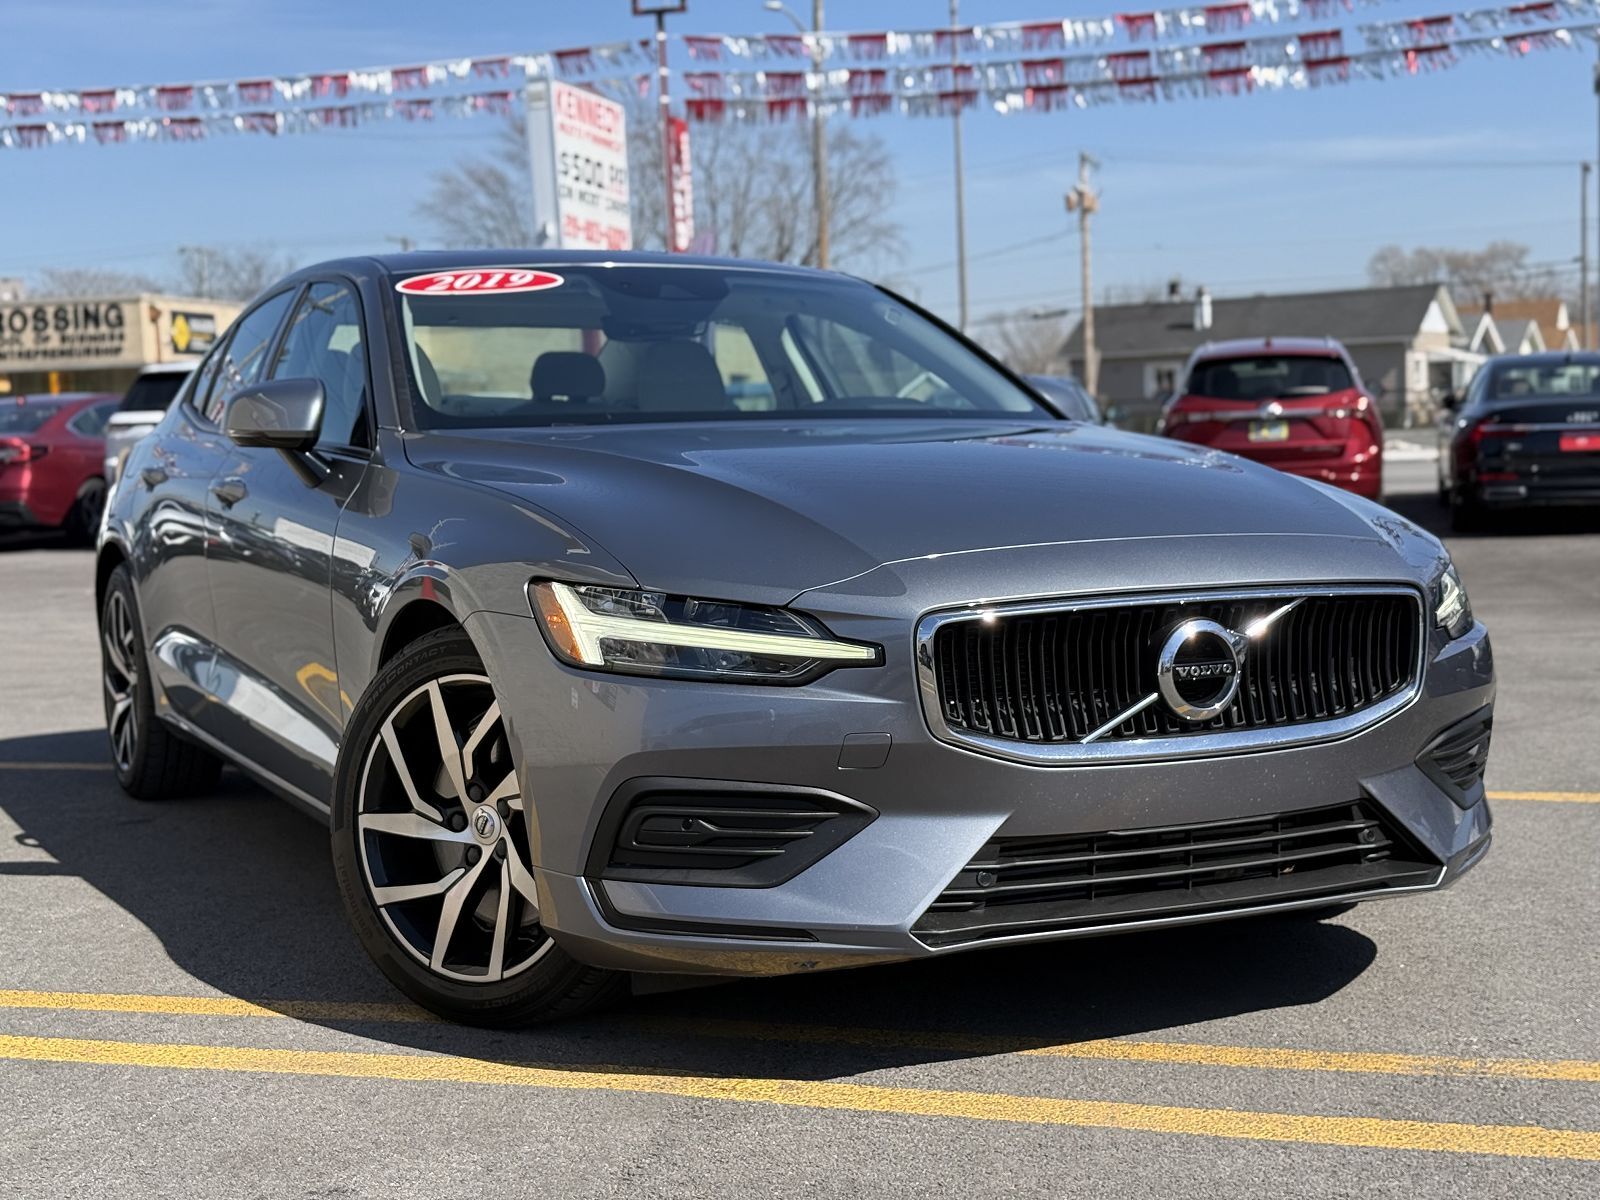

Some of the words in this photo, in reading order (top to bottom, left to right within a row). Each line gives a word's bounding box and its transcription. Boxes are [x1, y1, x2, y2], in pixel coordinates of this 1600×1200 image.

[424, 273, 534, 291] 2019
[0, 303, 124, 334] OSSING
[1175, 663, 1233, 678] VOLVO
